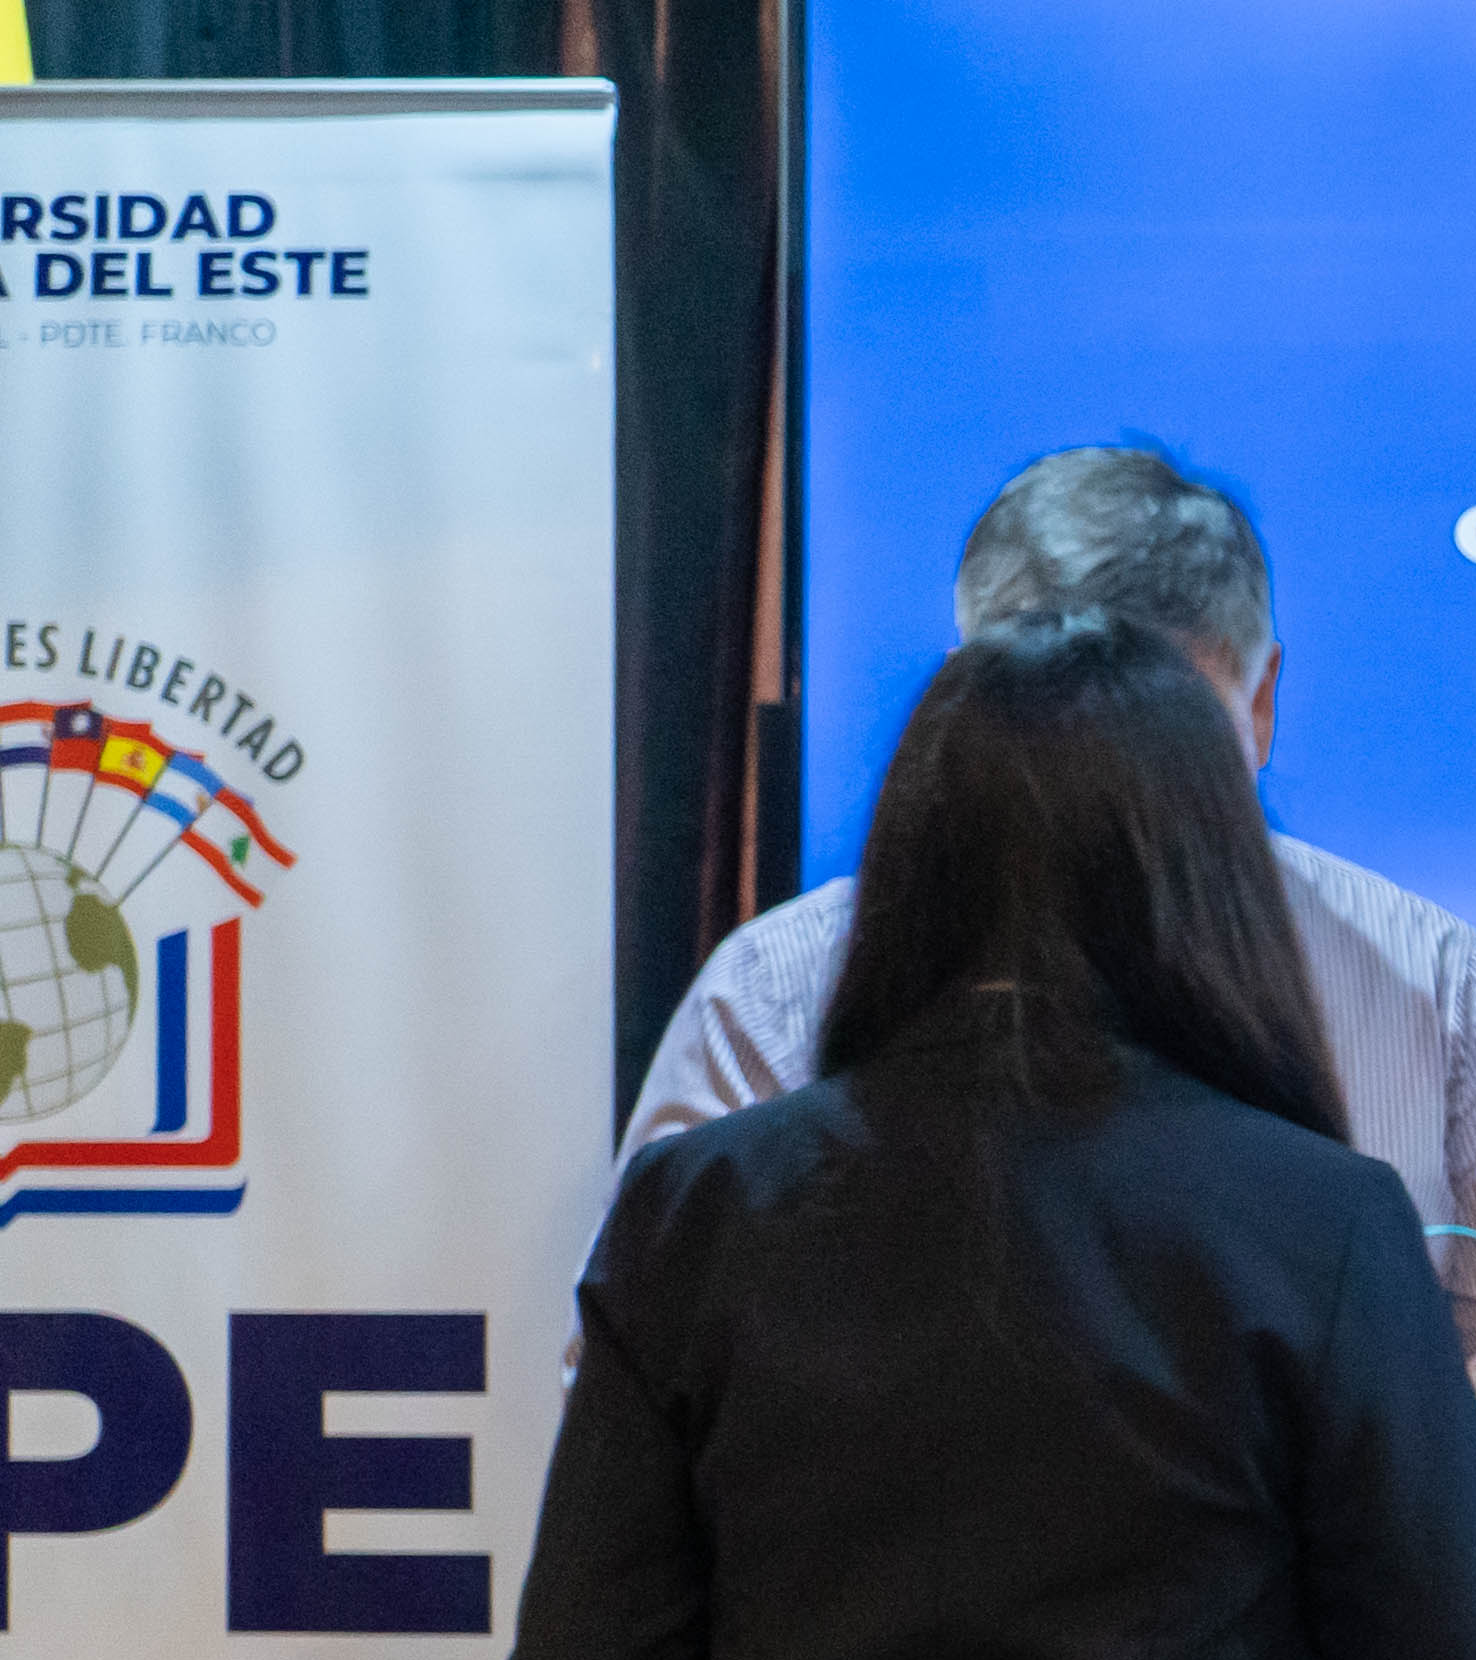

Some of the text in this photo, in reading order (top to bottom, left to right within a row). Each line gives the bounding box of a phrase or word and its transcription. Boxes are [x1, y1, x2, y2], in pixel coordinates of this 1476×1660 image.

[0, 194, 277, 242] RSIDAD
[35, 251, 174, 298] DEL
[198, 250, 370, 298] ESTE
[141, 318, 278, 349] FRANCO
[6, 622, 306, 782] ES LIBERTAD
